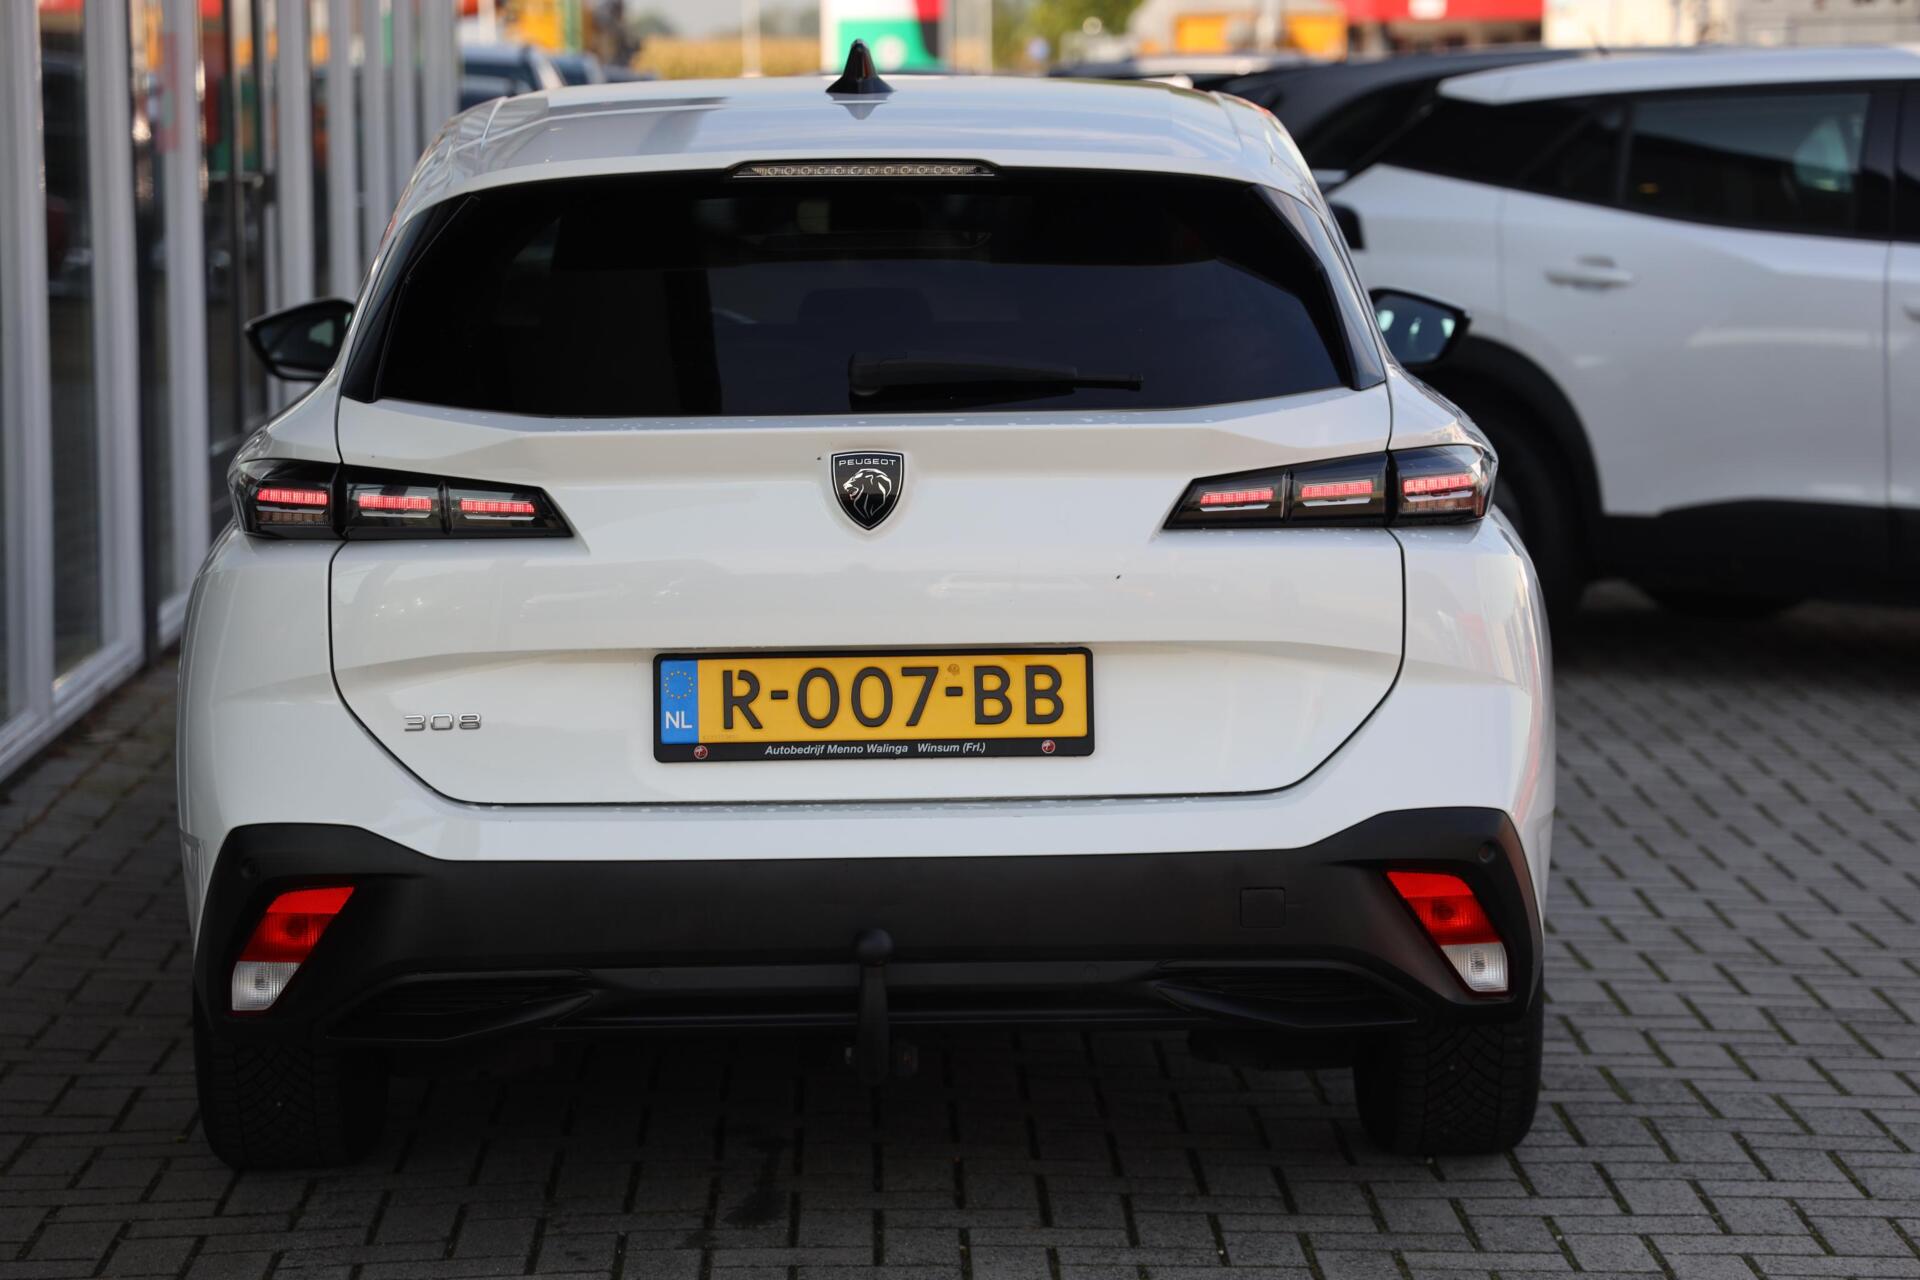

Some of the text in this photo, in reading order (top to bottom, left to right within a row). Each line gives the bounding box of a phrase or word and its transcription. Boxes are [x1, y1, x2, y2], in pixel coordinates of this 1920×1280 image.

[838, 458, 897, 466] PEUGEOT
[722, 665, 1065, 730] R-007-BB
[404, 713, 481, 732] 308
[665, 710, 693, 729] NL
[765, 742, 986, 756] Autobedrijf Menno Walinga Winsum (Frl.)
